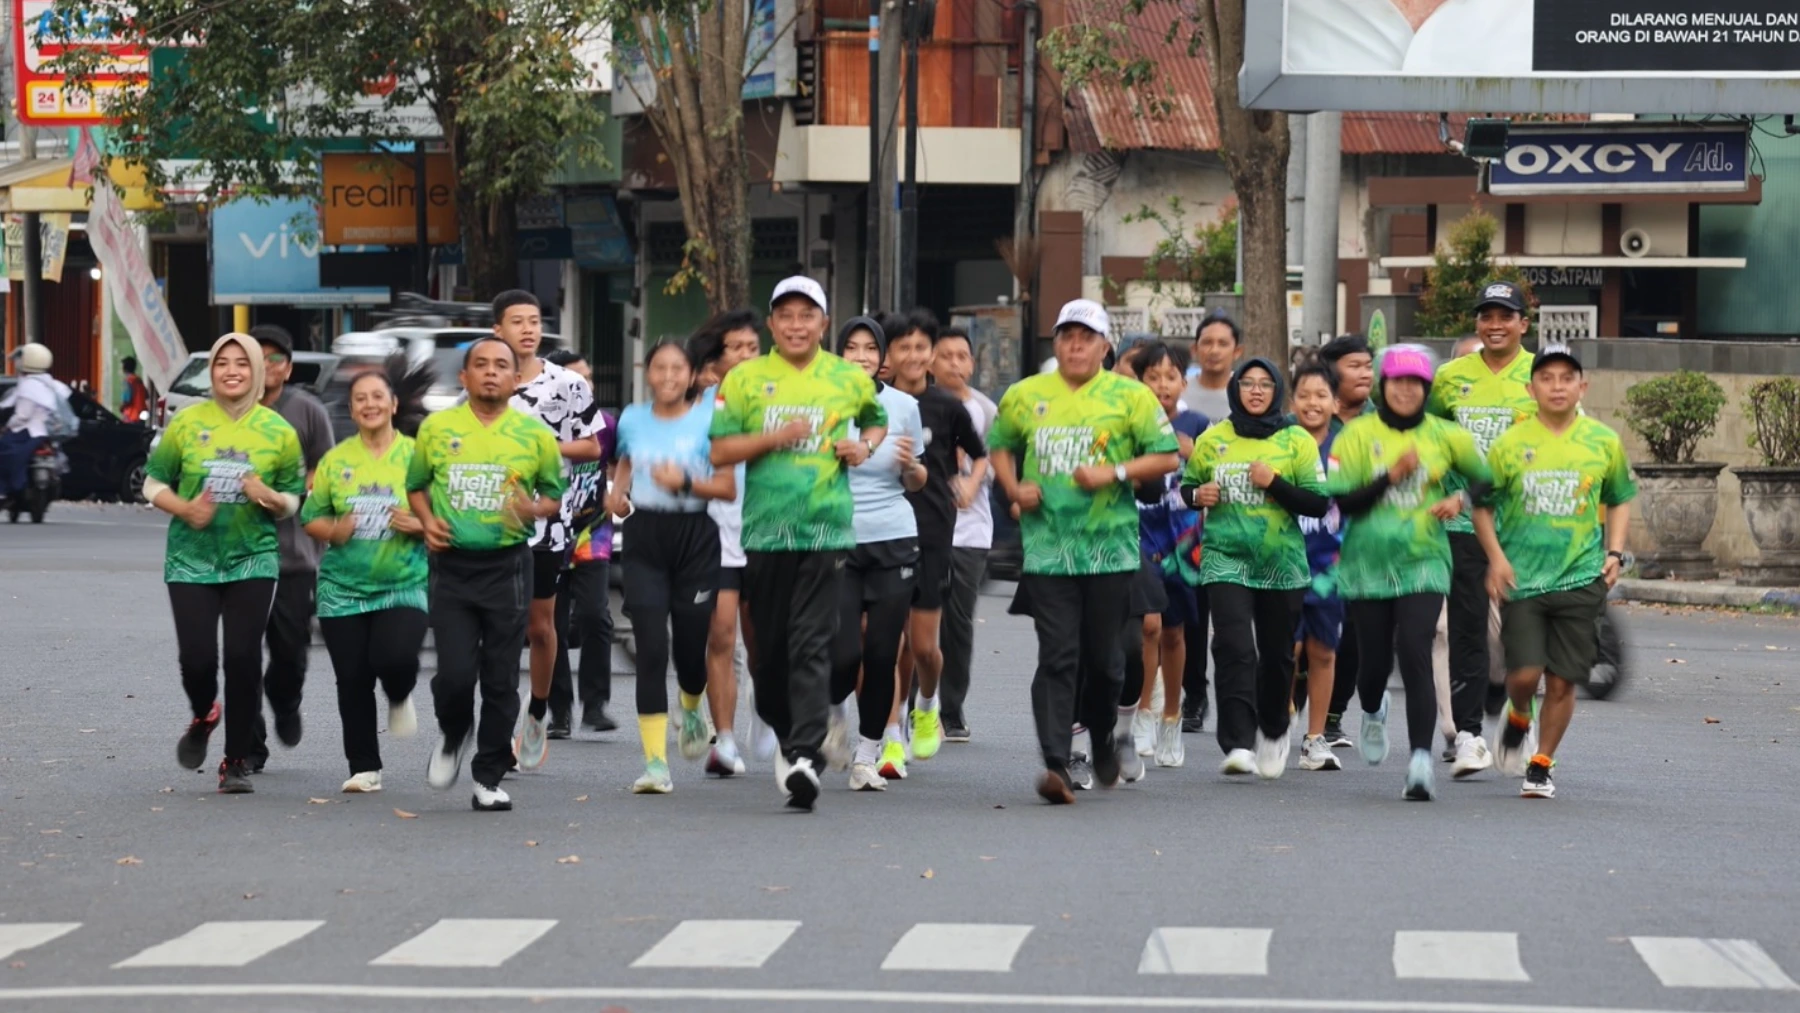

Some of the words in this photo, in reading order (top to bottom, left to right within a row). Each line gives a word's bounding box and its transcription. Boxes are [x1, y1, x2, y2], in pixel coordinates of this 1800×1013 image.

[1610, 13, 1687, 26] DILARANG
[1691, 13, 1762, 26] MENJUAL
[1766, 13, 1798, 26] DAN
[1575, 30, 1631, 43] ORANG
[1635, 30, 1650, 43] DI
[1654, 30, 1708, 43] BAWAH
[1712, 30, 1729, 43] 21
[1733, 30, 1784, 43] TAHUN
[1789, 30, 1800, 43] D
[38, 92, 55, 104] 24
[1504, 143, 1683, 175] OXCY
[1683, 142, 1734, 172] Ad.
[331, 182, 450, 208] realme
[1550, 268, 1603, 286] SATPAM
[1034, 432, 1094, 458] NIGHT
[446, 471, 506, 497] NIGHT
[1521, 475, 1580, 502] NIGHT
[461, 490, 506, 512] RUN
[1228, 486, 1265, 506] RUN
[1534, 496, 1577, 517] RUN
